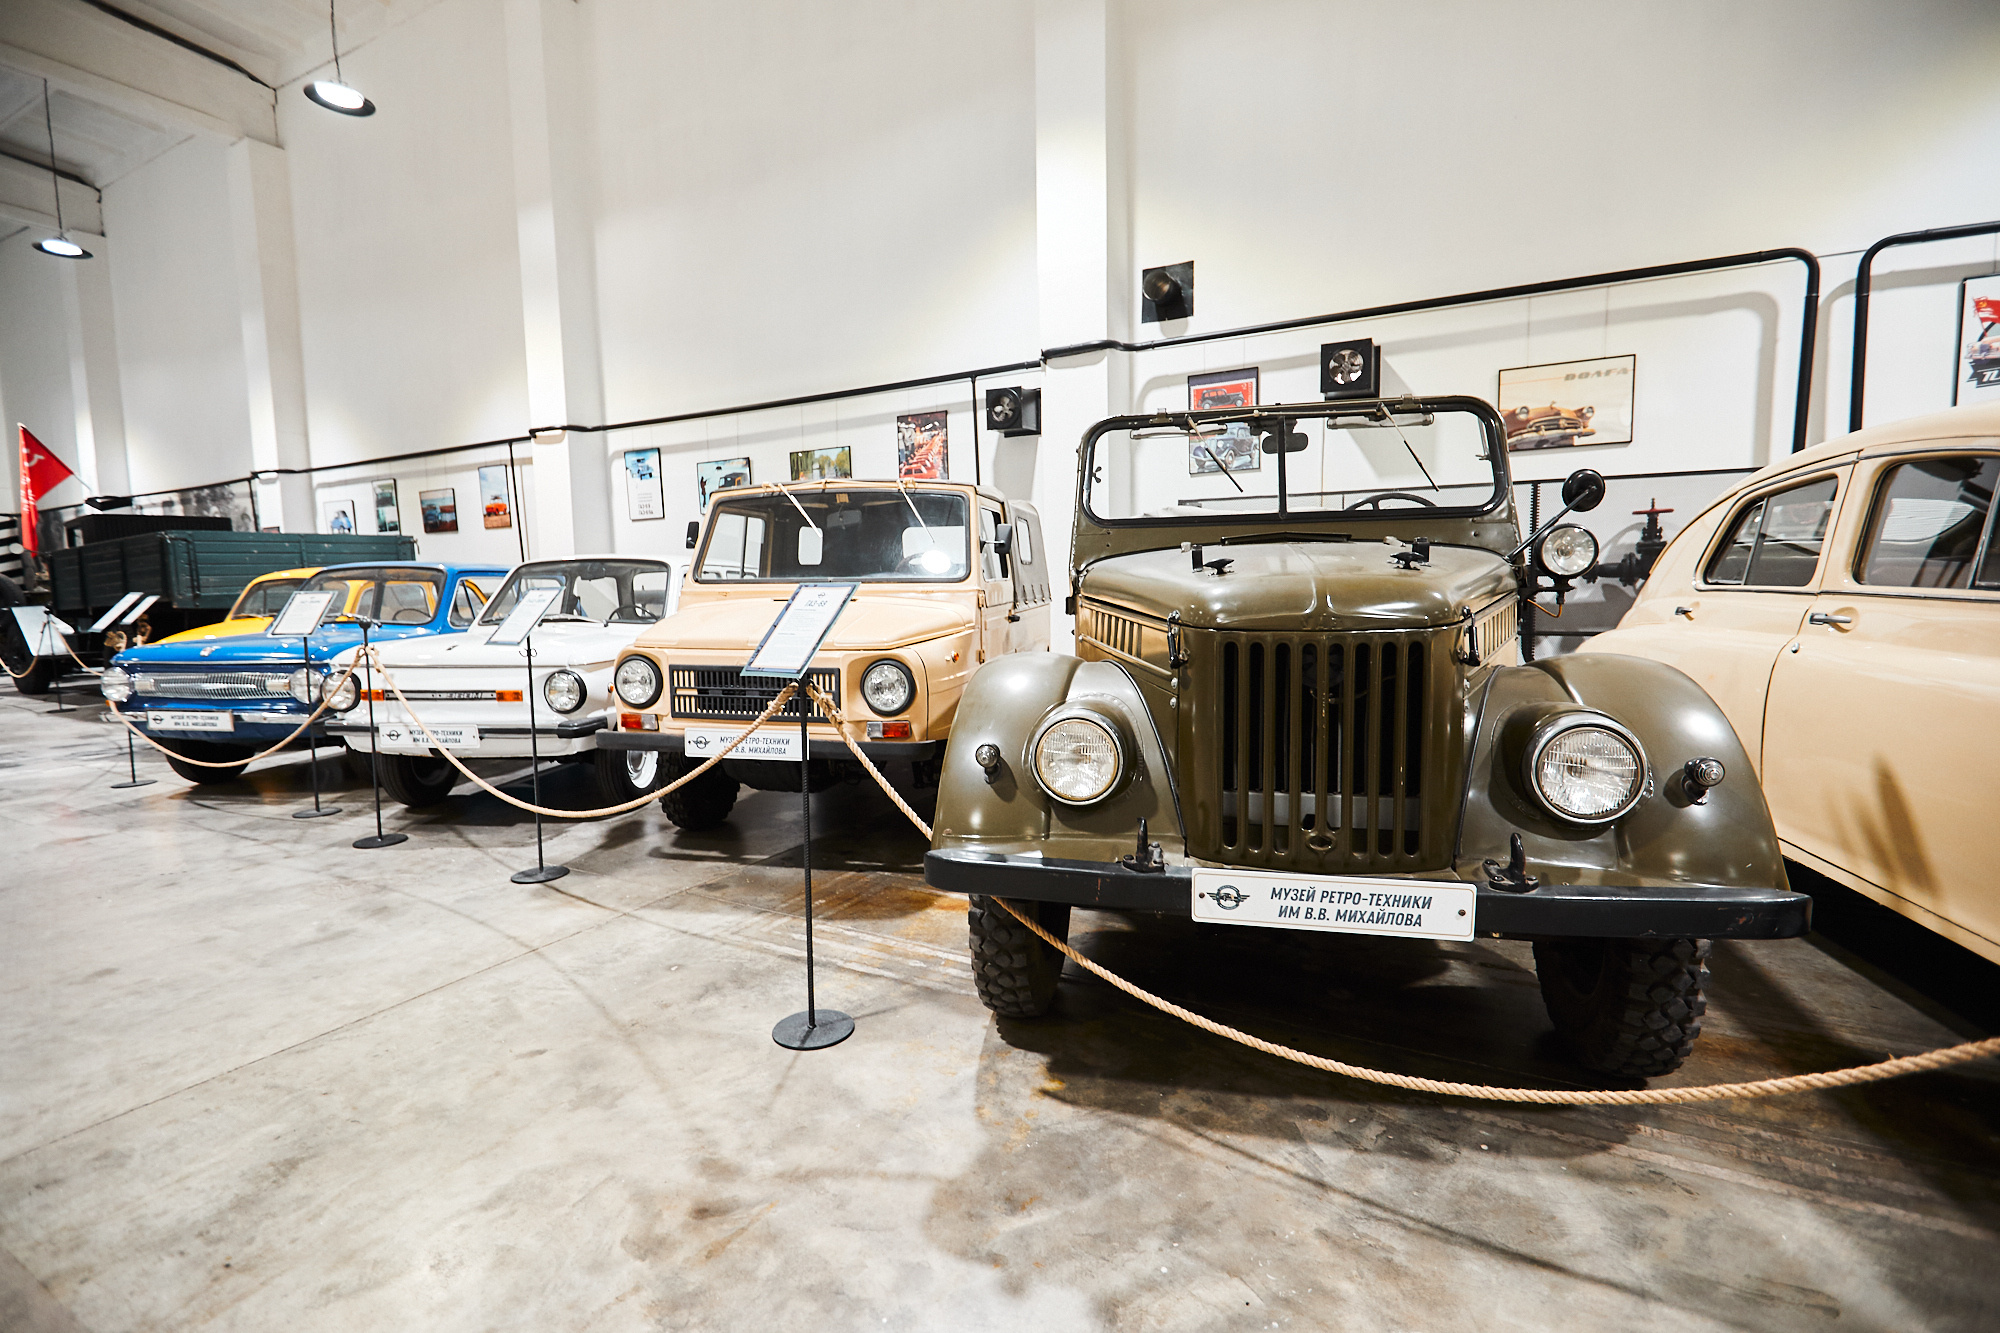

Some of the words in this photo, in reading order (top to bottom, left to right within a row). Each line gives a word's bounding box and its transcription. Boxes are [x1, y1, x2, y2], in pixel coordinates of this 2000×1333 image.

[748, 746, 787, 755] МИХАЙЛОВА
[1270, 886, 1316, 902] МУЗЕЙ
[1320, 890, 1433, 910] РЕТРО-ТЕХНИКИ
[1278, 905, 1301, 919] ИМ
[1304, 907, 1330, 921] В.В.
[1335, 907, 1423, 927] МИХАЙЛОВА
